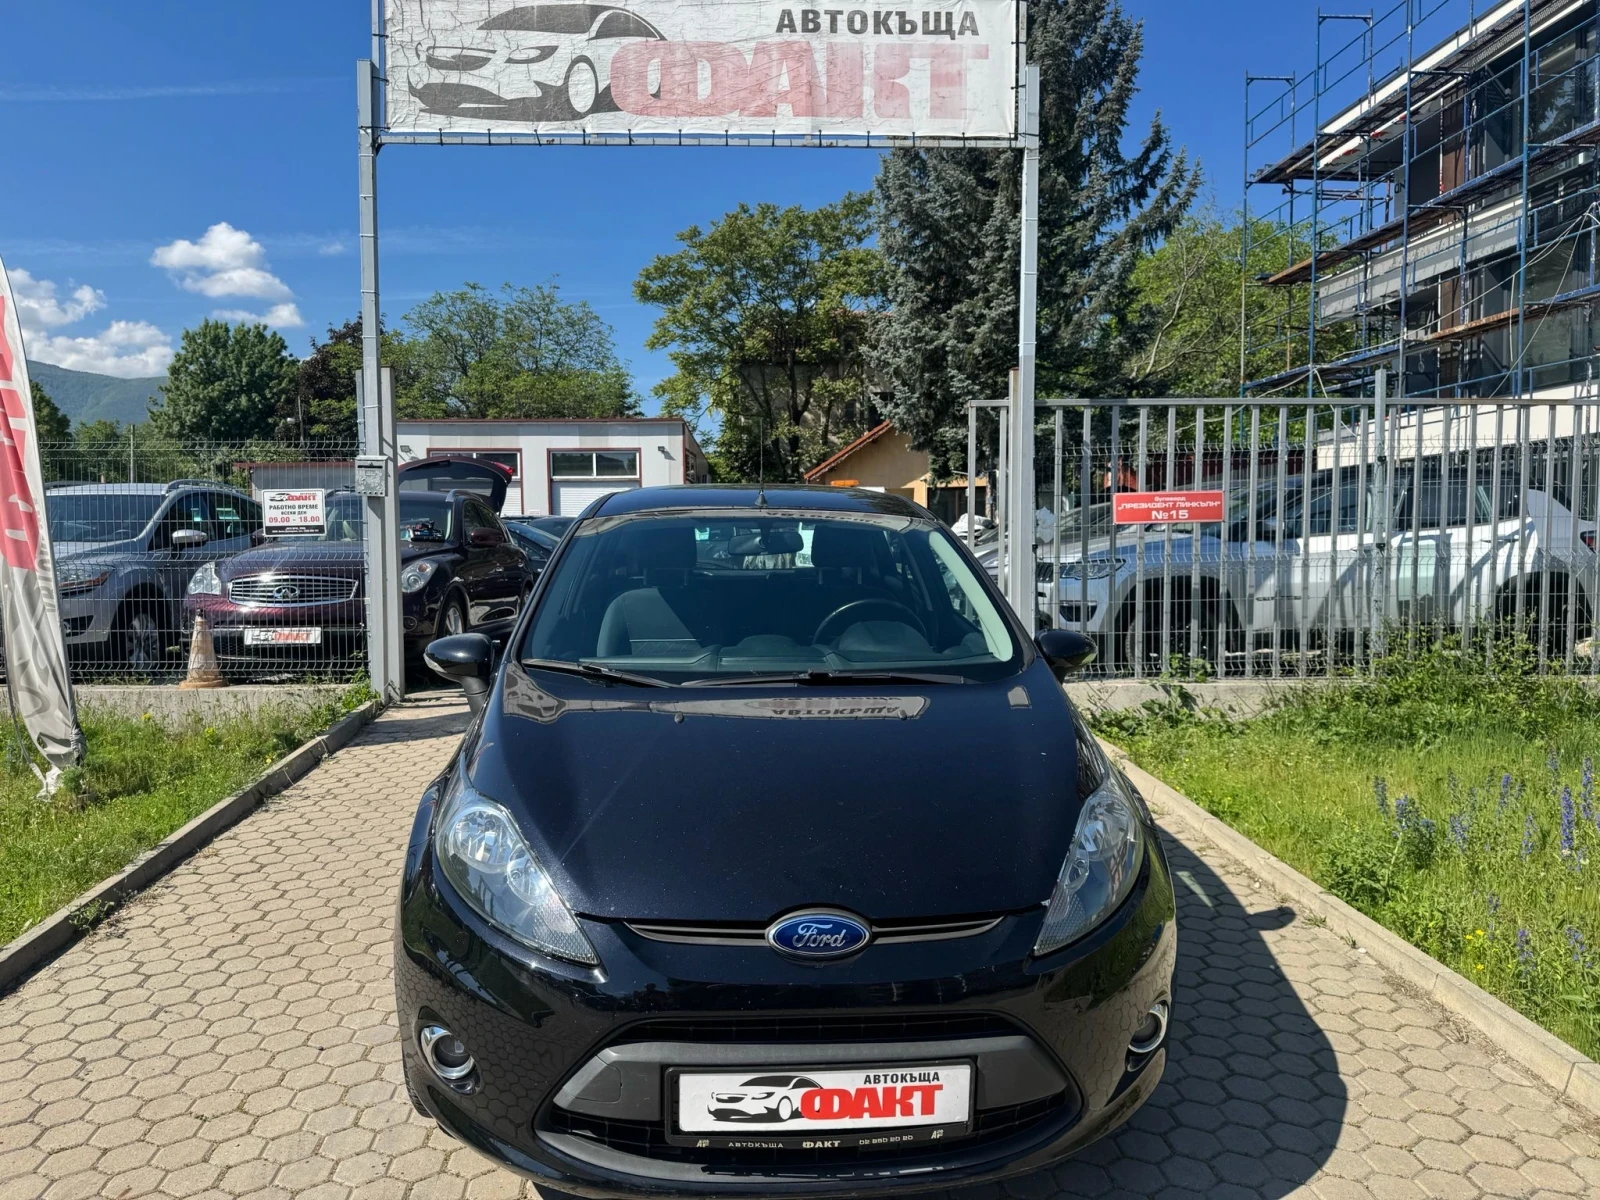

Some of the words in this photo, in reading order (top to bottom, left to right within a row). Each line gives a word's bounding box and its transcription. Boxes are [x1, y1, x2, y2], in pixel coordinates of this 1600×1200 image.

[775, 8, 979, 39] АВТОКЪЩА
[609, 40, 989, 119] ФАКТ
[792, 922, 848, 948] Ford
[863, 1071, 941, 1085] АВТОКЪЩА
[800, 1084, 943, 1120] ФАКТ
[802, 1140, 841, 1149] ФАКТ
